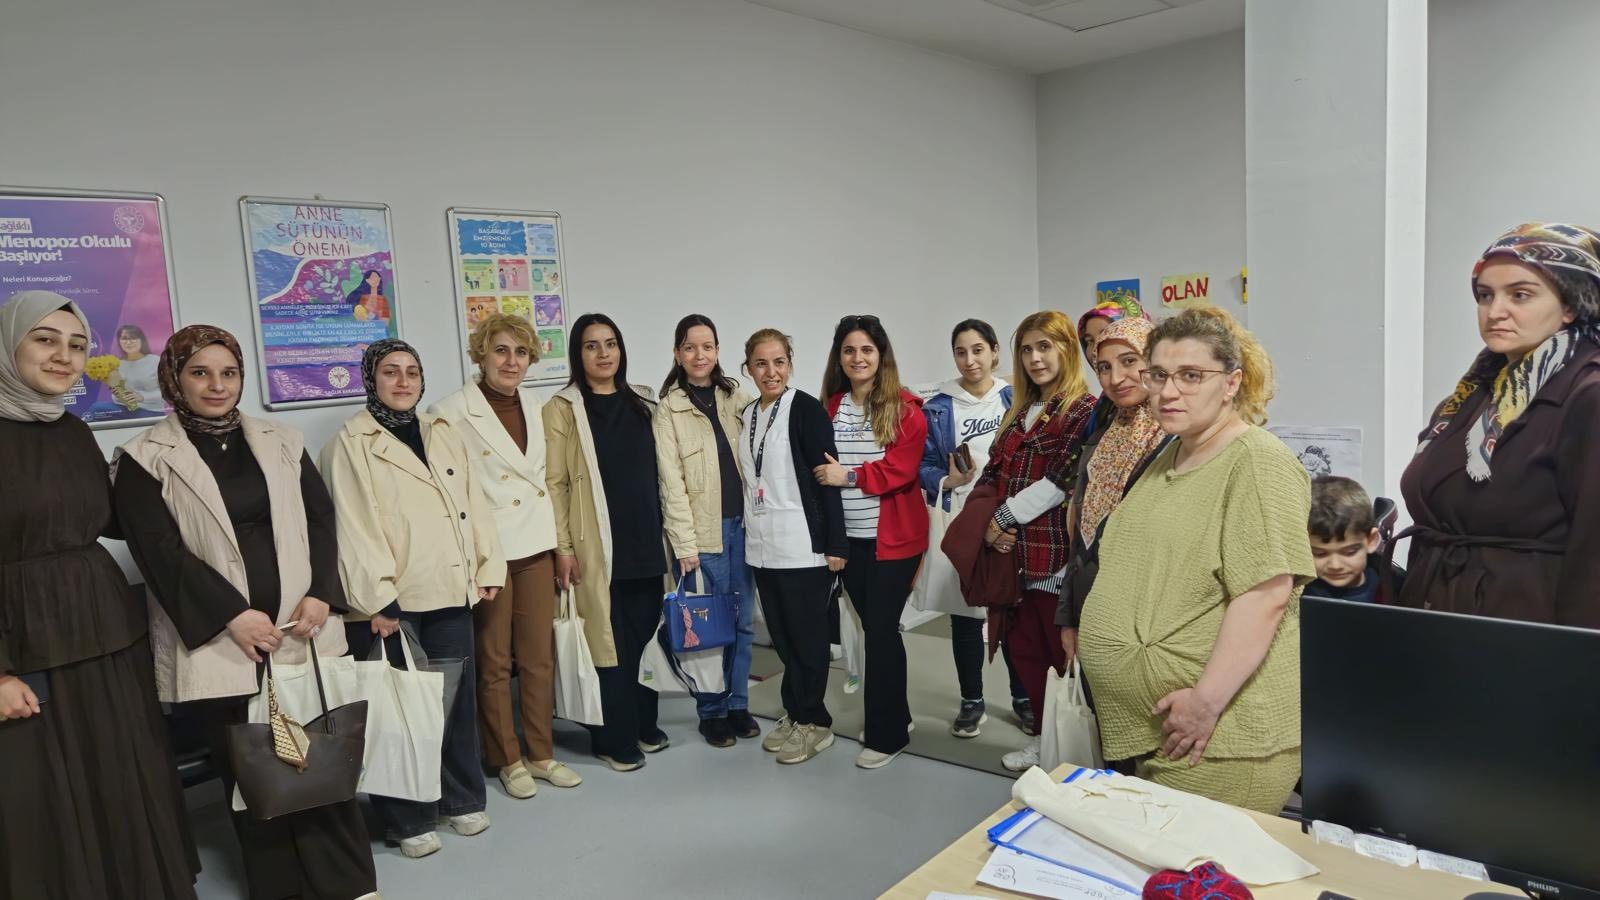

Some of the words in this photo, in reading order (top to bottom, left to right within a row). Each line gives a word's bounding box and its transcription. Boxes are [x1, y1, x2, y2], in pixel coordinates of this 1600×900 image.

[294, 206, 343, 221] ANNE
[276, 220, 362, 240] SÜTÜNÜN
[80, 235, 132, 248] Okulu
[293, 239, 350, 256] ÖNEMİ
[0, 249, 63, 266] Başlıyor!
[3, 275, 26, 283] Neleri
[27, 275, 72, 283] Konuşacağız?
[1162, 277, 1209, 302] OLAN
[961, 415, 1001, 436] Mavi
[1527, 880, 1560, 894] PHILIPS
